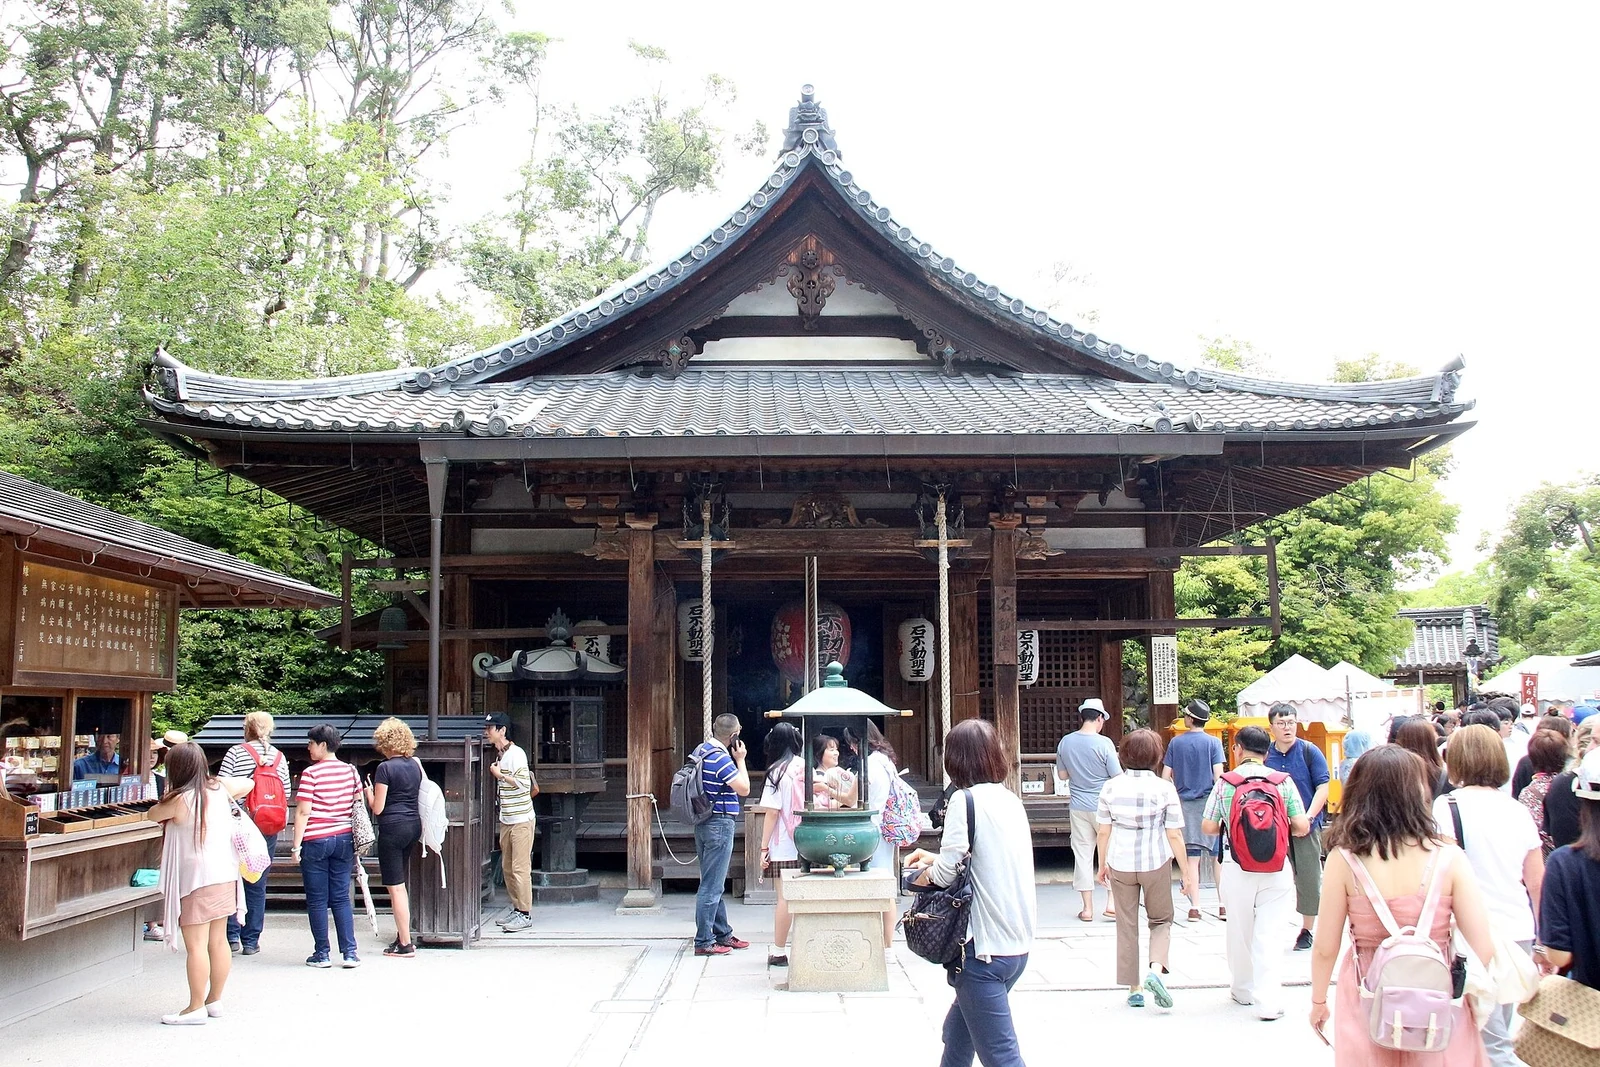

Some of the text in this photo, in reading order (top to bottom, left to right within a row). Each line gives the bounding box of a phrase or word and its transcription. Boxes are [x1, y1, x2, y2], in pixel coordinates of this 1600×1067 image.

[38, 578, 48, 643] 無病息災
[47, 580, 57, 644] 家内安全
[56, 583, 66, 645] 心願成就
[65, 584, 74, 646] 学業成就
[909, 625, 927, 678] 石不動明王
[1017, 629, 1034, 682] 石不動明王
